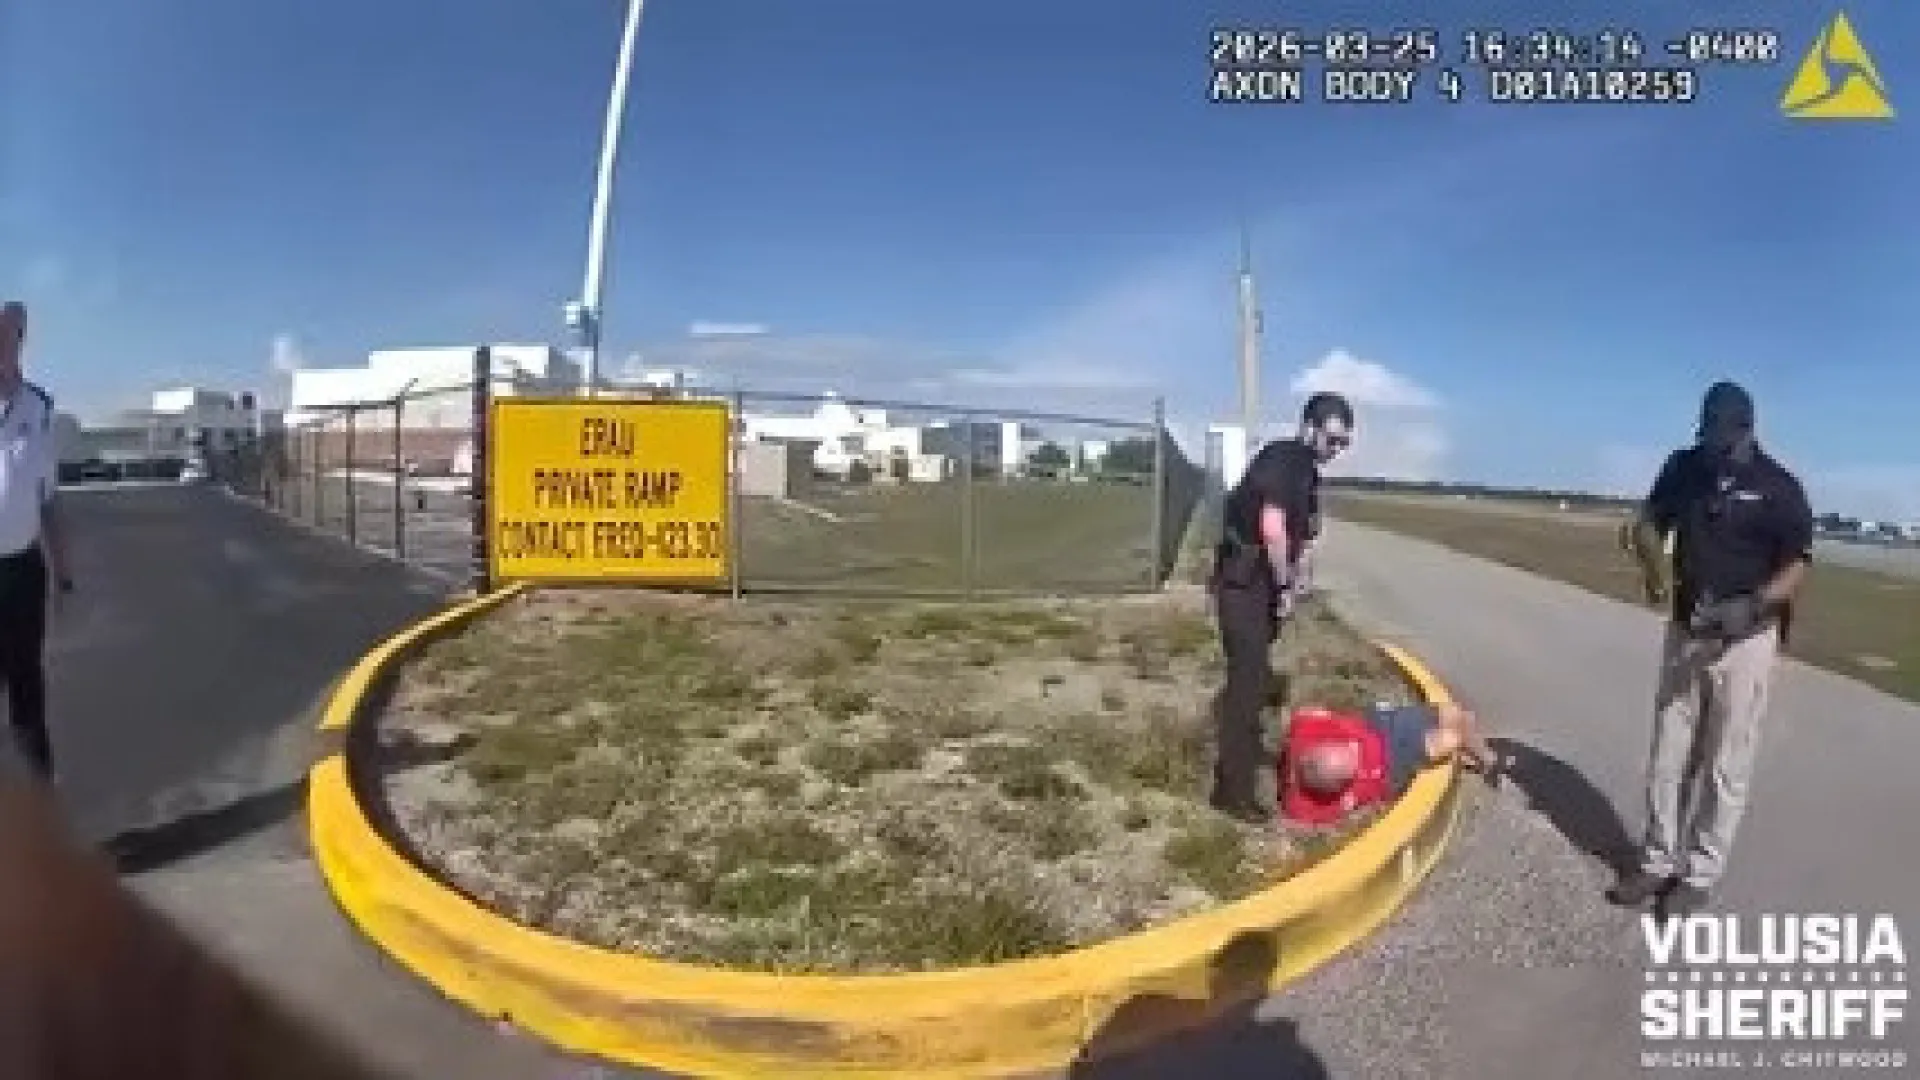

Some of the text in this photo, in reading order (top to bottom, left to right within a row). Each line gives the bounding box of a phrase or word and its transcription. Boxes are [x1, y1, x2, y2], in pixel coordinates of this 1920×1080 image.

[579, 418, 635, 457] ERAU
[534, 469, 682, 511] PRIVATE RAMP
[500, 521, 586, 560] CONTACT
